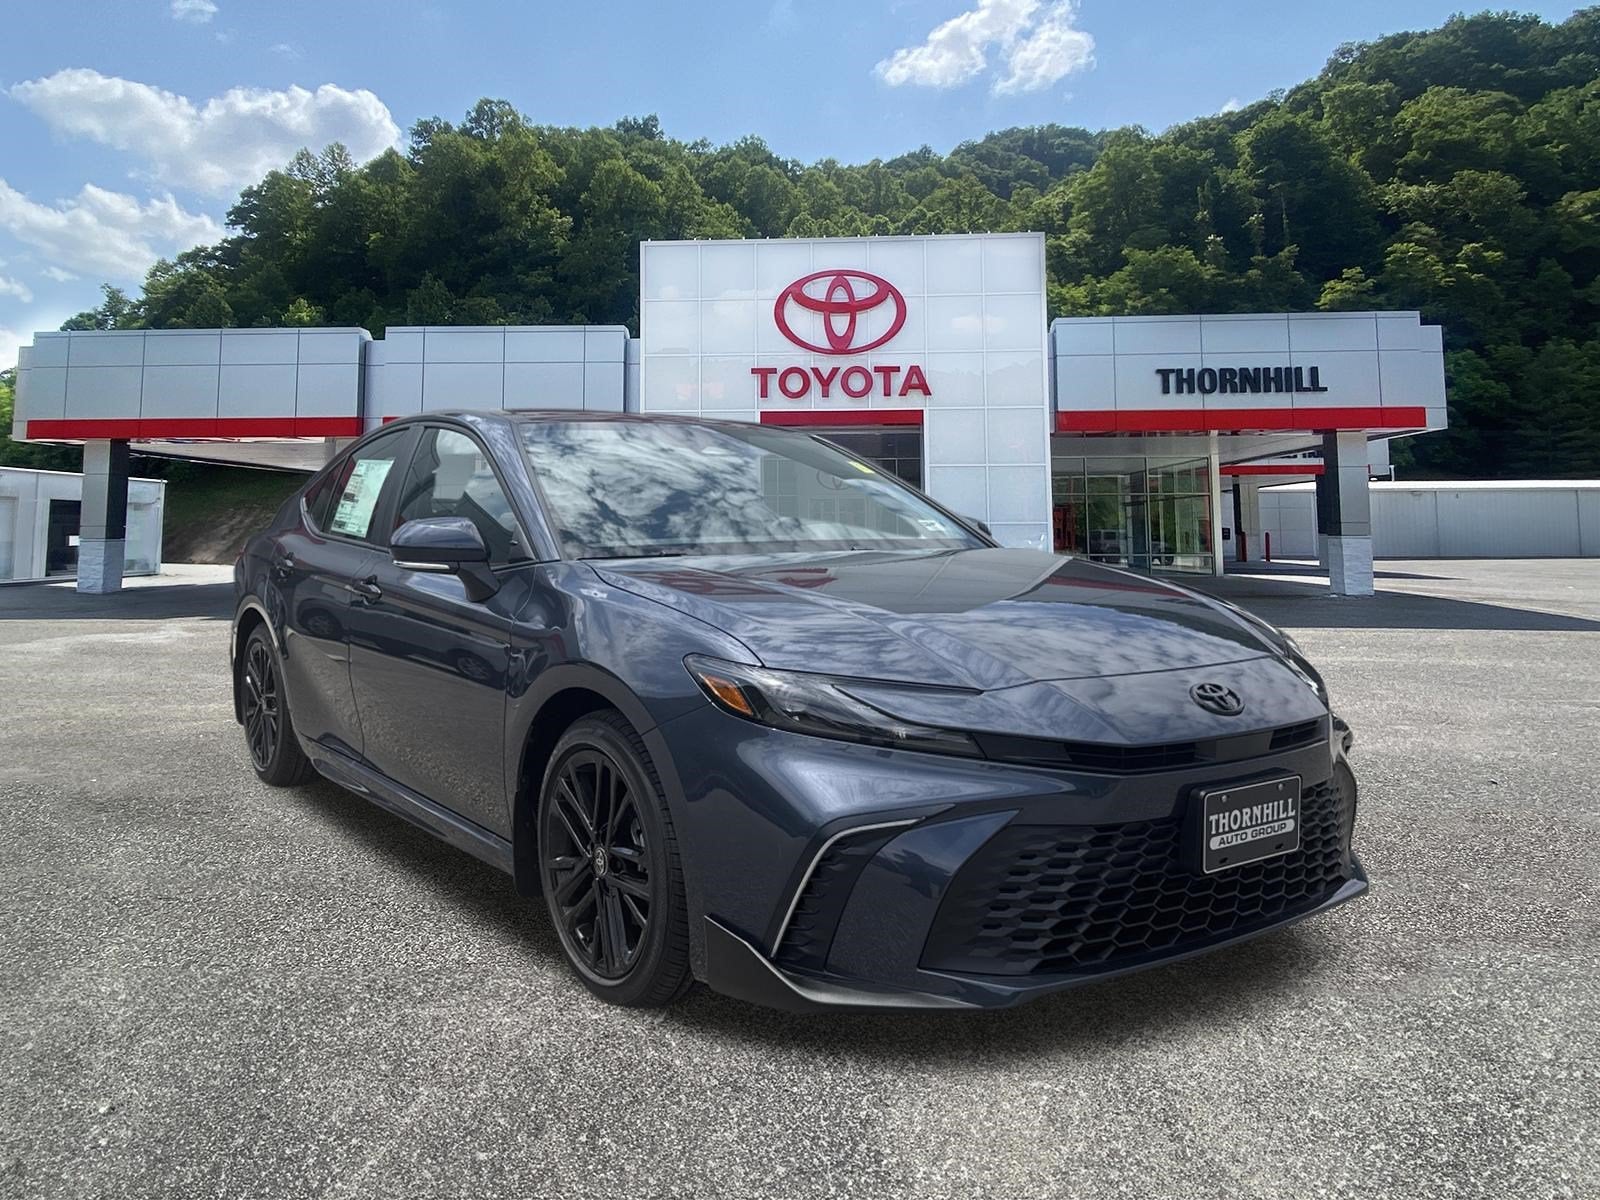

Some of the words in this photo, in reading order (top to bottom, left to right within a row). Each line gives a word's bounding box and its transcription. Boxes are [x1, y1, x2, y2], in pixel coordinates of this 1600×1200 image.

[751, 365, 932, 399] TOYOTA
[1156, 366, 1328, 394] THORNHILL
[1209, 798, 1295, 834] THORNHILL
[1218, 832, 1247, 846] AUTO
[1251, 822, 1286, 838] GROUP
